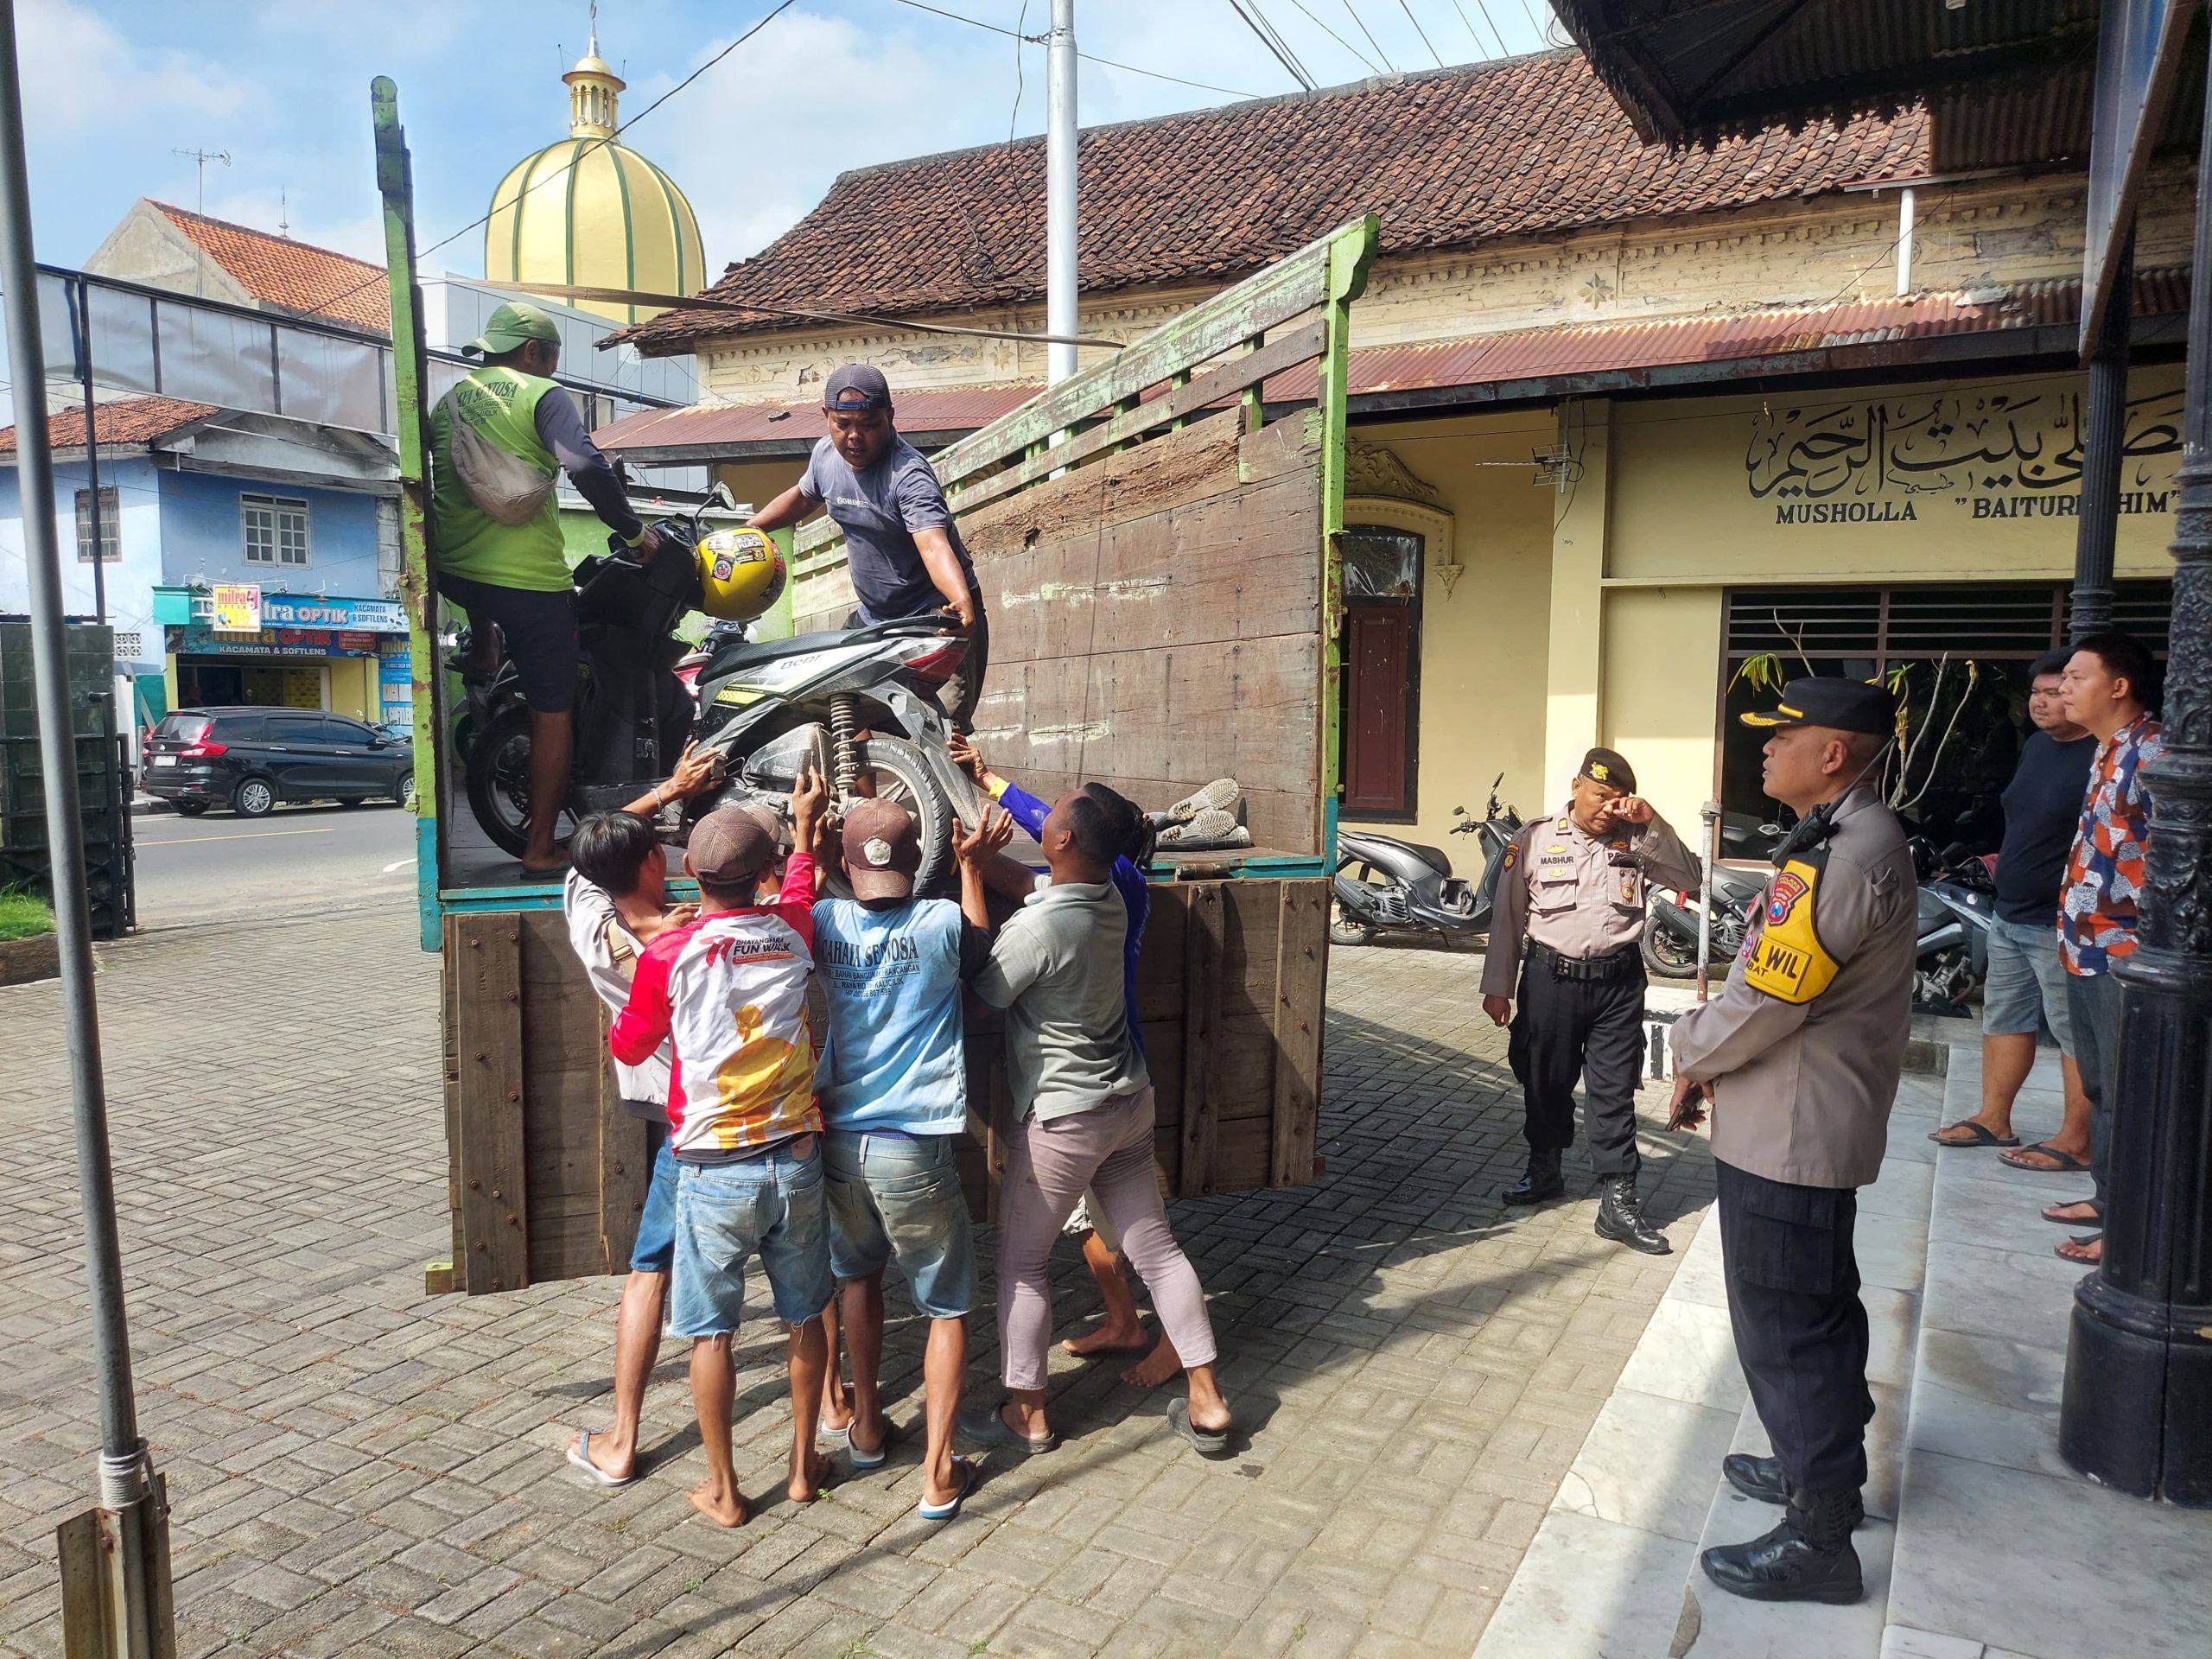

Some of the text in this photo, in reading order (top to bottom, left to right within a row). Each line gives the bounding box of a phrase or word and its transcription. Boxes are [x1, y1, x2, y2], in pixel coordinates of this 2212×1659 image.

[1776, 500, 1917, 524] MUSHOLLA
[218, 588, 246, 603] mitra
[261, 601, 349, 624] tra OPTIK
[354, 604, 386, 613] KACAMATA
[358, 613, 388, 623] SOFTLENS
[279, 629, 332, 645] OPTIK
[219, 645, 327, 656] KACAMATA & SOFTLENS
[1540, 855, 1574, 865] MASHUR
[733, 944, 760, 956] FUN
[1765, 944, 1799, 979] WIL
